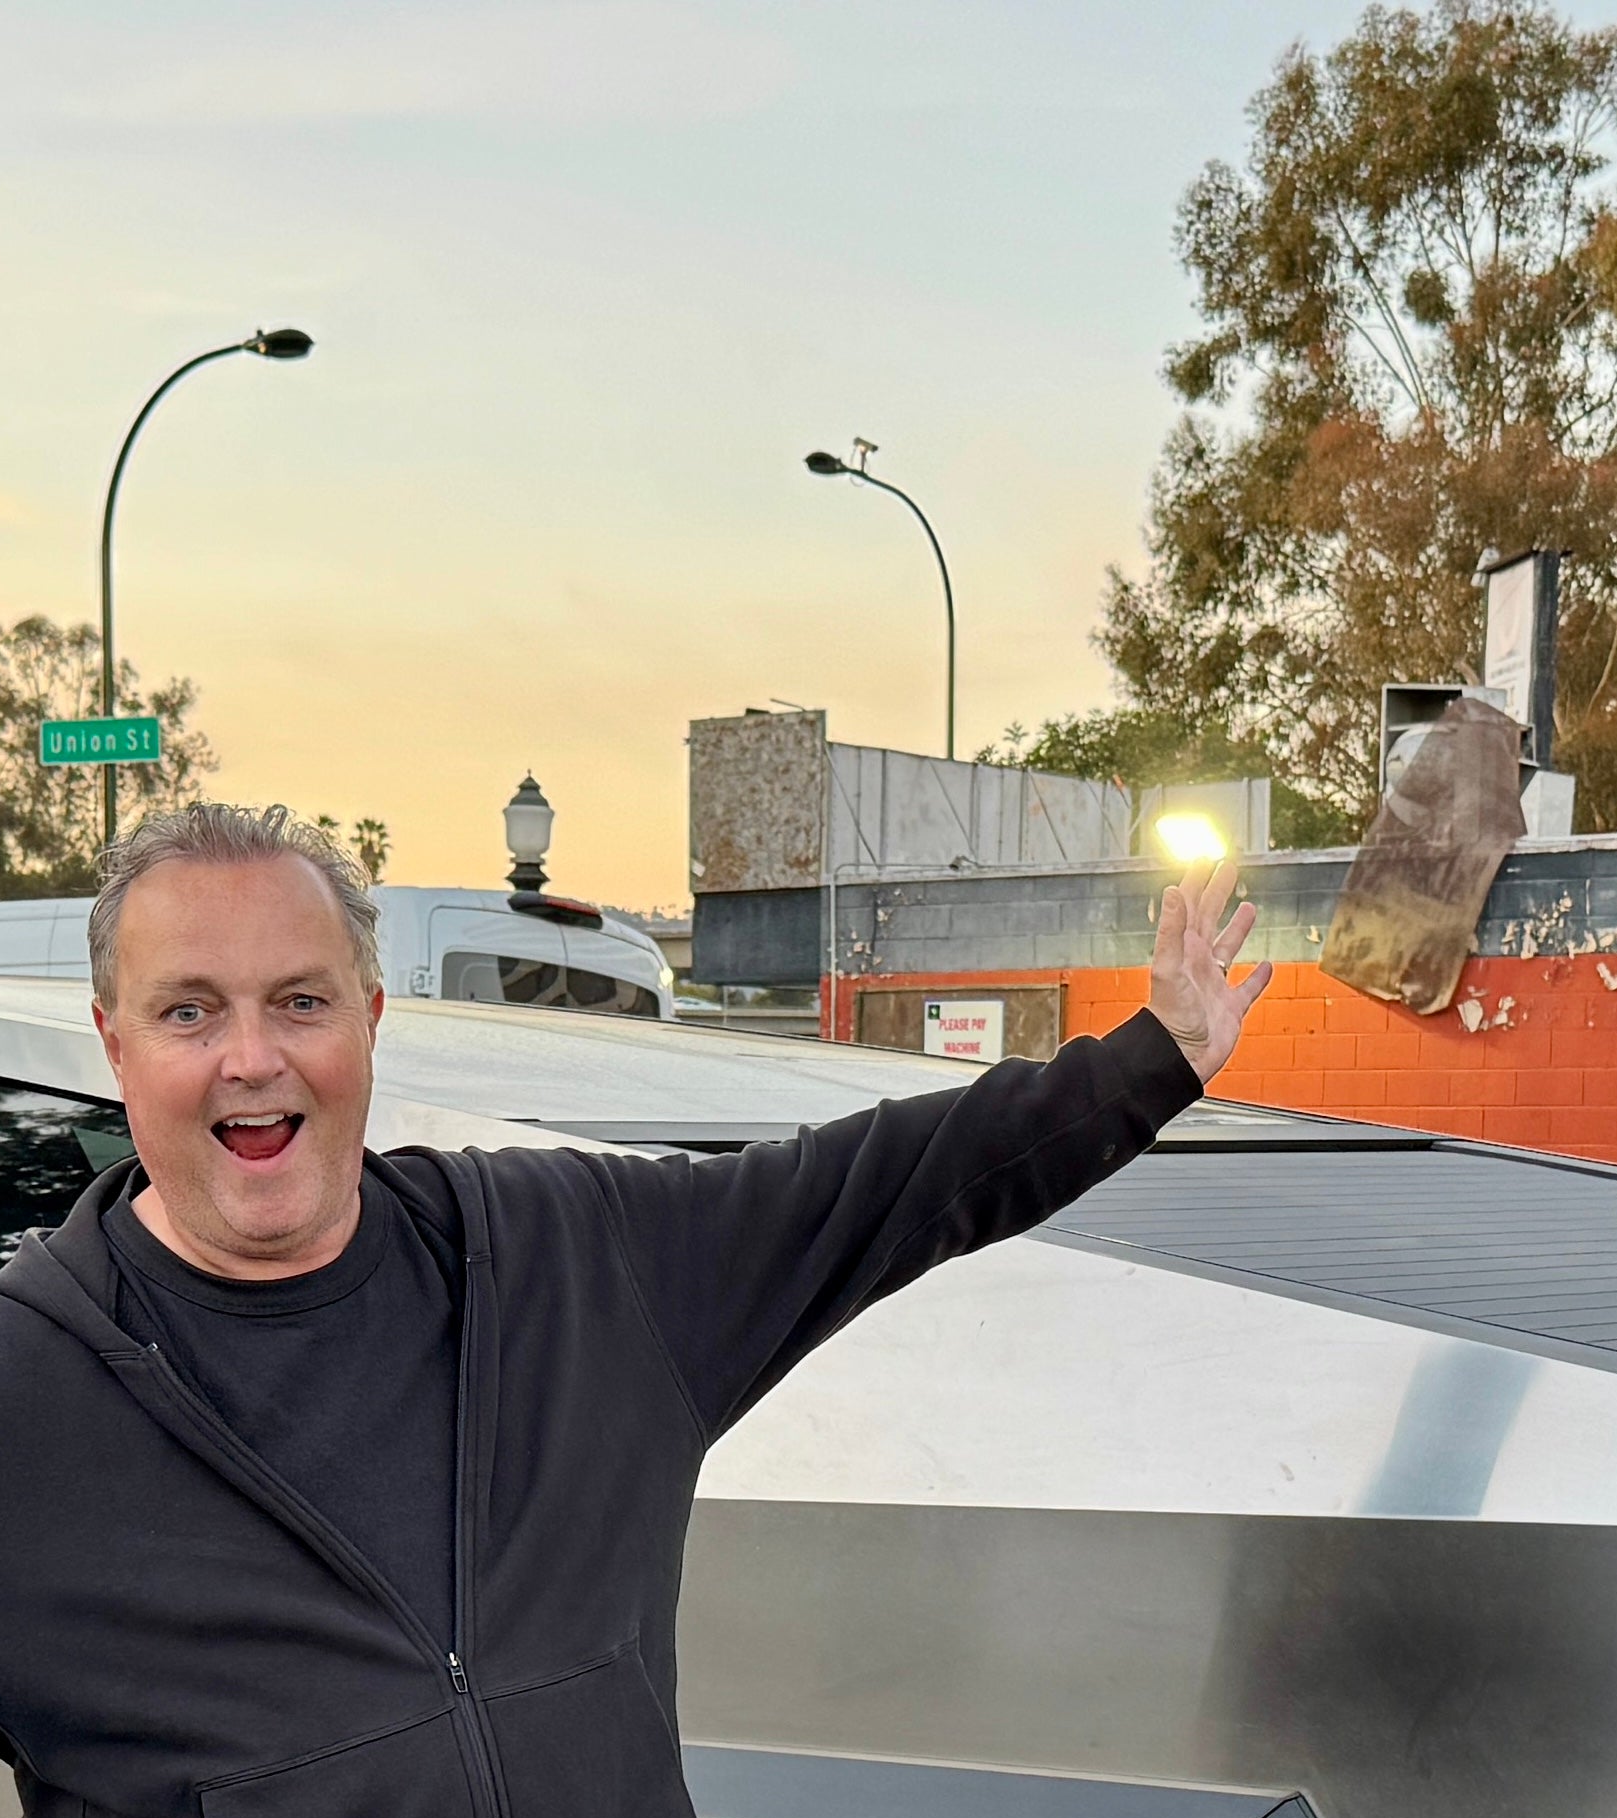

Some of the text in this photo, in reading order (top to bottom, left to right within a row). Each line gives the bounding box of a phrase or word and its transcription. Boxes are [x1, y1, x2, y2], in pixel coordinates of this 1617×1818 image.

[50, 728, 150, 753] Union St
[939, 1018, 986, 1031] PLEASE PAY
[944, 1042, 981, 1054] MACHINE
